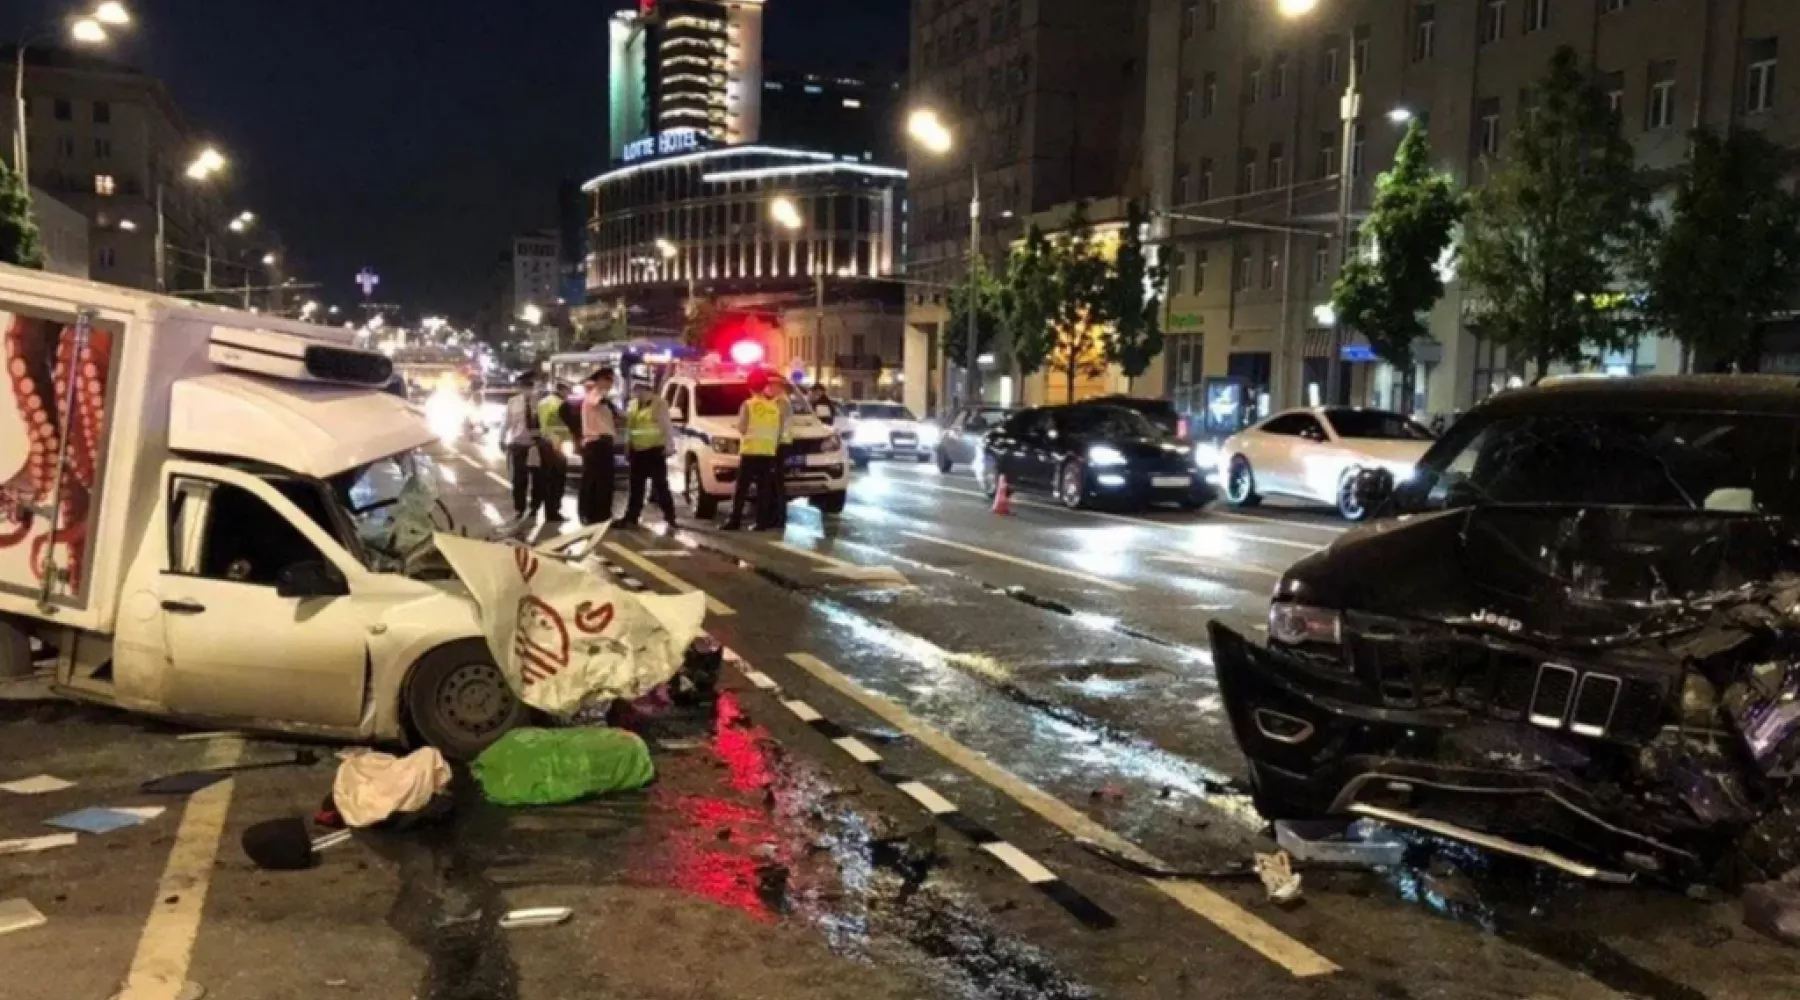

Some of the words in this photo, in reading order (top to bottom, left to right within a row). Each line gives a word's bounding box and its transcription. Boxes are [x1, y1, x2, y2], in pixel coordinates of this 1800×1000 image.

[623, 137, 655, 161] LOTTE
[658, 129, 698, 154] HOTEL
[1470, 607, 1523, 633] Jeep
